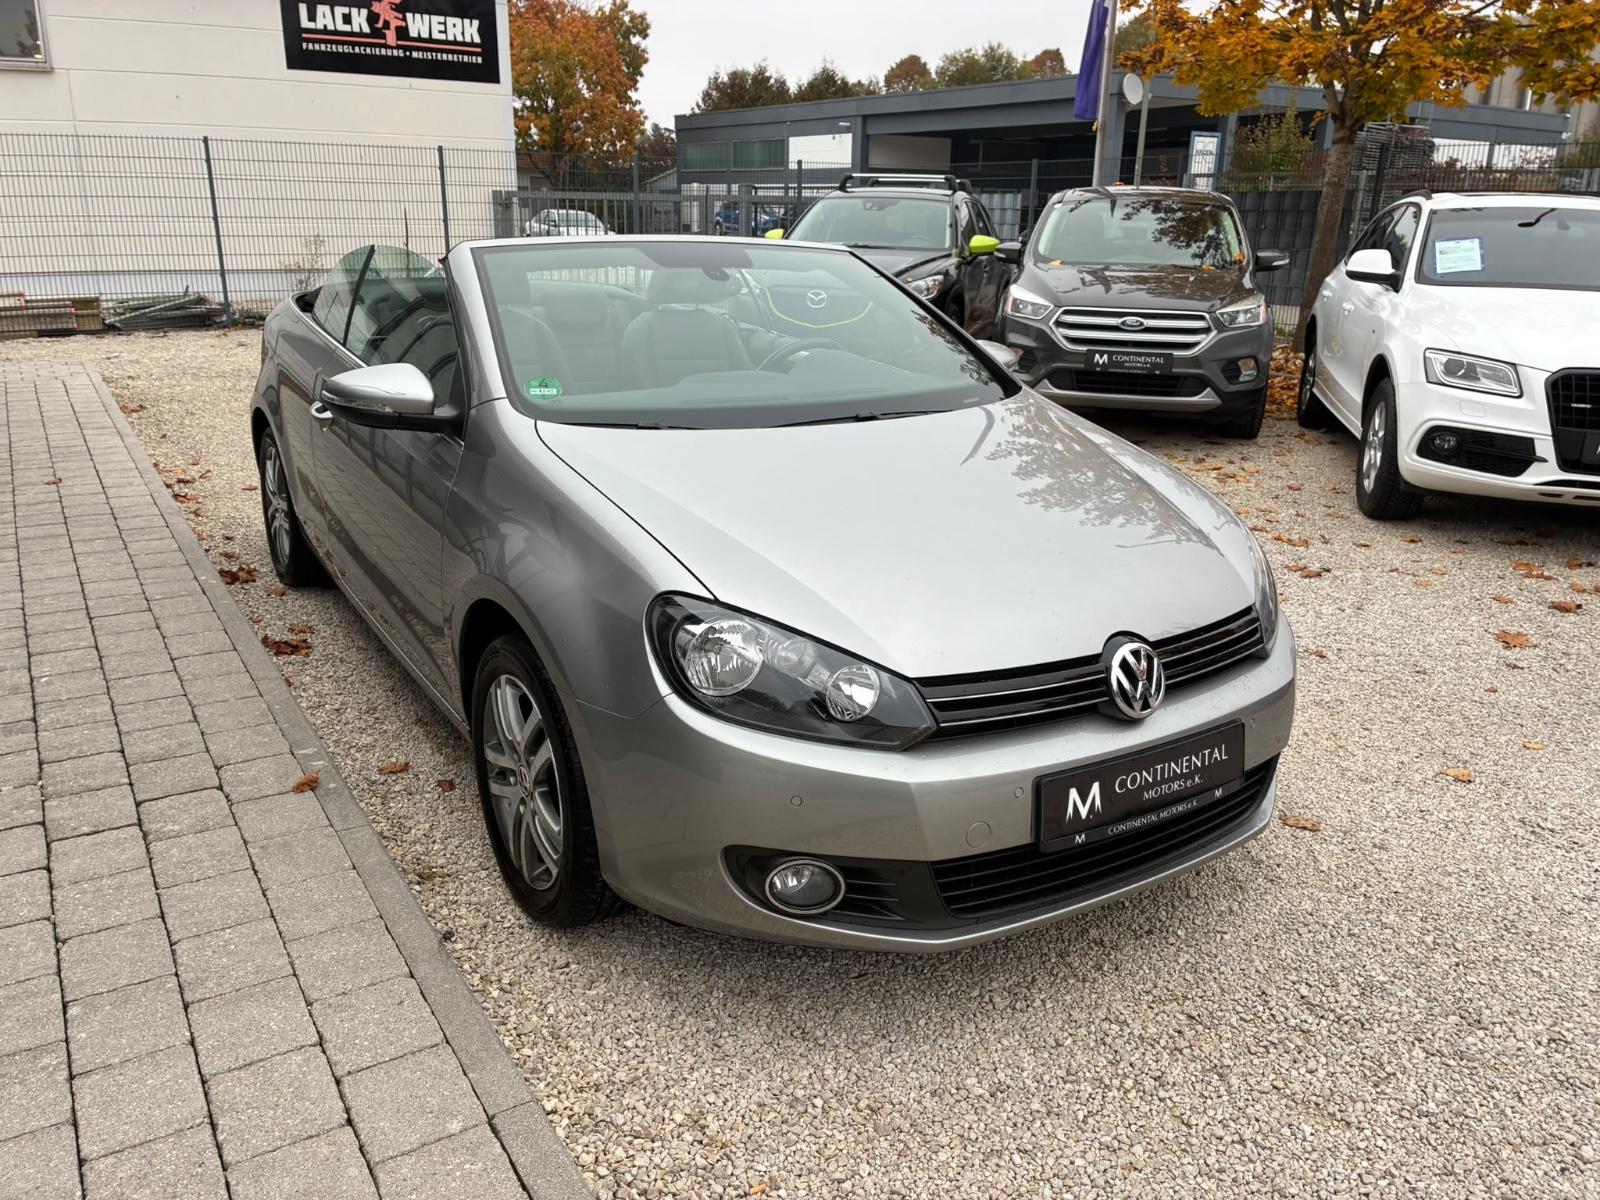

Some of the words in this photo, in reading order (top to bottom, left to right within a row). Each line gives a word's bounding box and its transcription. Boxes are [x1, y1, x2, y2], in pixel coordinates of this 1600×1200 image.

[298, 3, 371, 33] LACK
[405, 12, 482, 44] WERK
[1112, 354, 1165, 364] CONTINENTAL
[538, 378, 548, 389] 4
[1115, 744, 1228, 793] CONTINENTAL
[1143, 778, 1185, 801] MOTORS
[1074, 833, 1086, 845] M
[1107, 814, 1159, 836] CONTINENTAL
[1159, 802, 1188, 820] MOTORS
[1214, 787, 1224, 799] M
